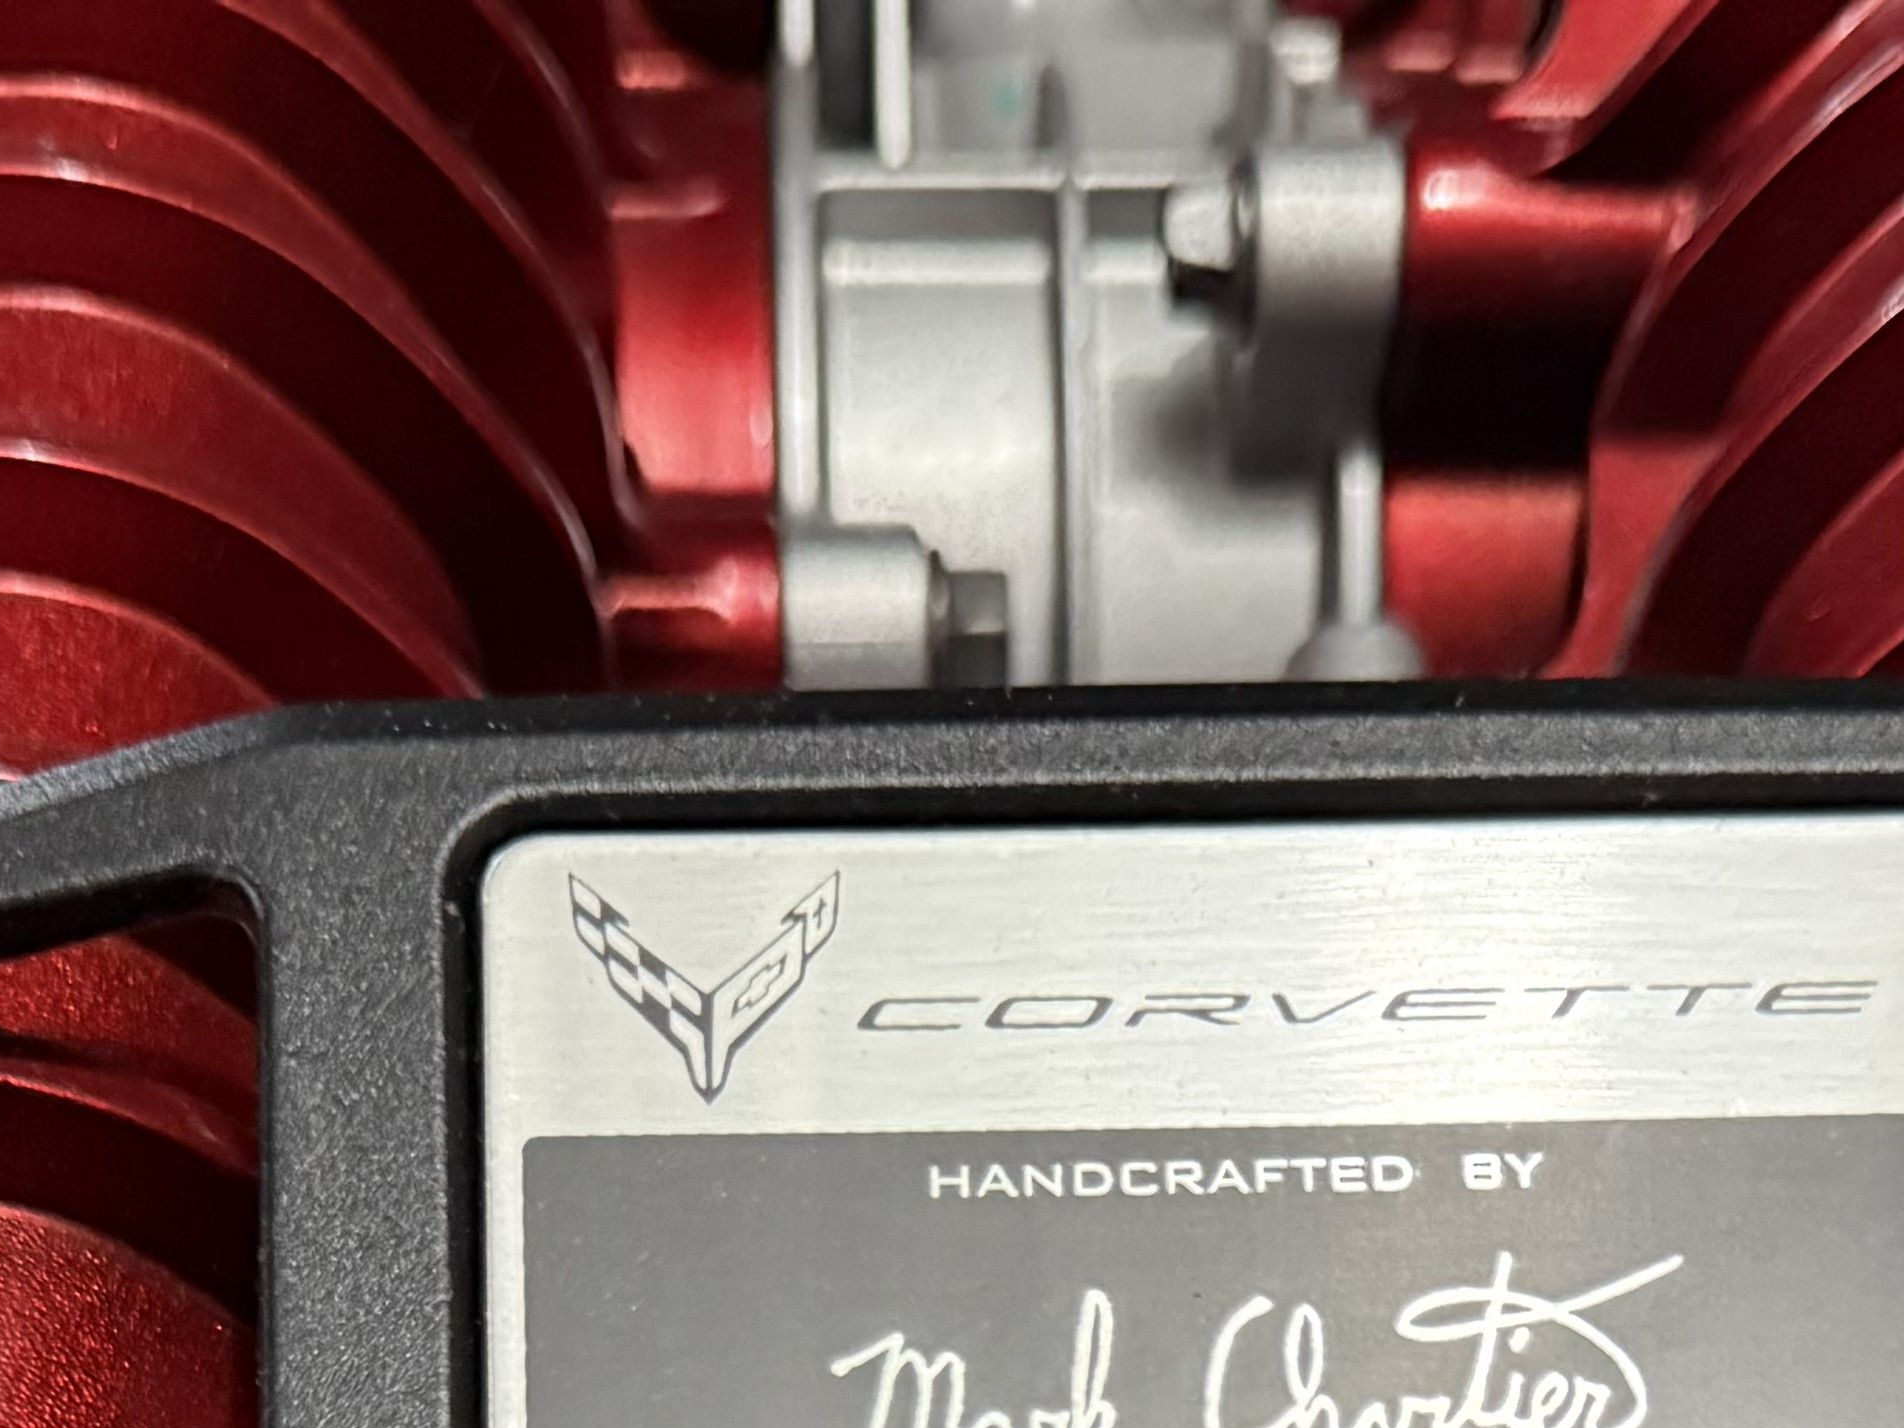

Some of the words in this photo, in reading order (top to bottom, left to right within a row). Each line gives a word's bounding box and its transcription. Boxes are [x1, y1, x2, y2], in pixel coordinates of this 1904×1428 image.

[857, 979, 1879, 1032] CORVETTE
[927, 1154, 1414, 1200] HANDCRAFTED
[1461, 1150, 1545, 1192] BY
